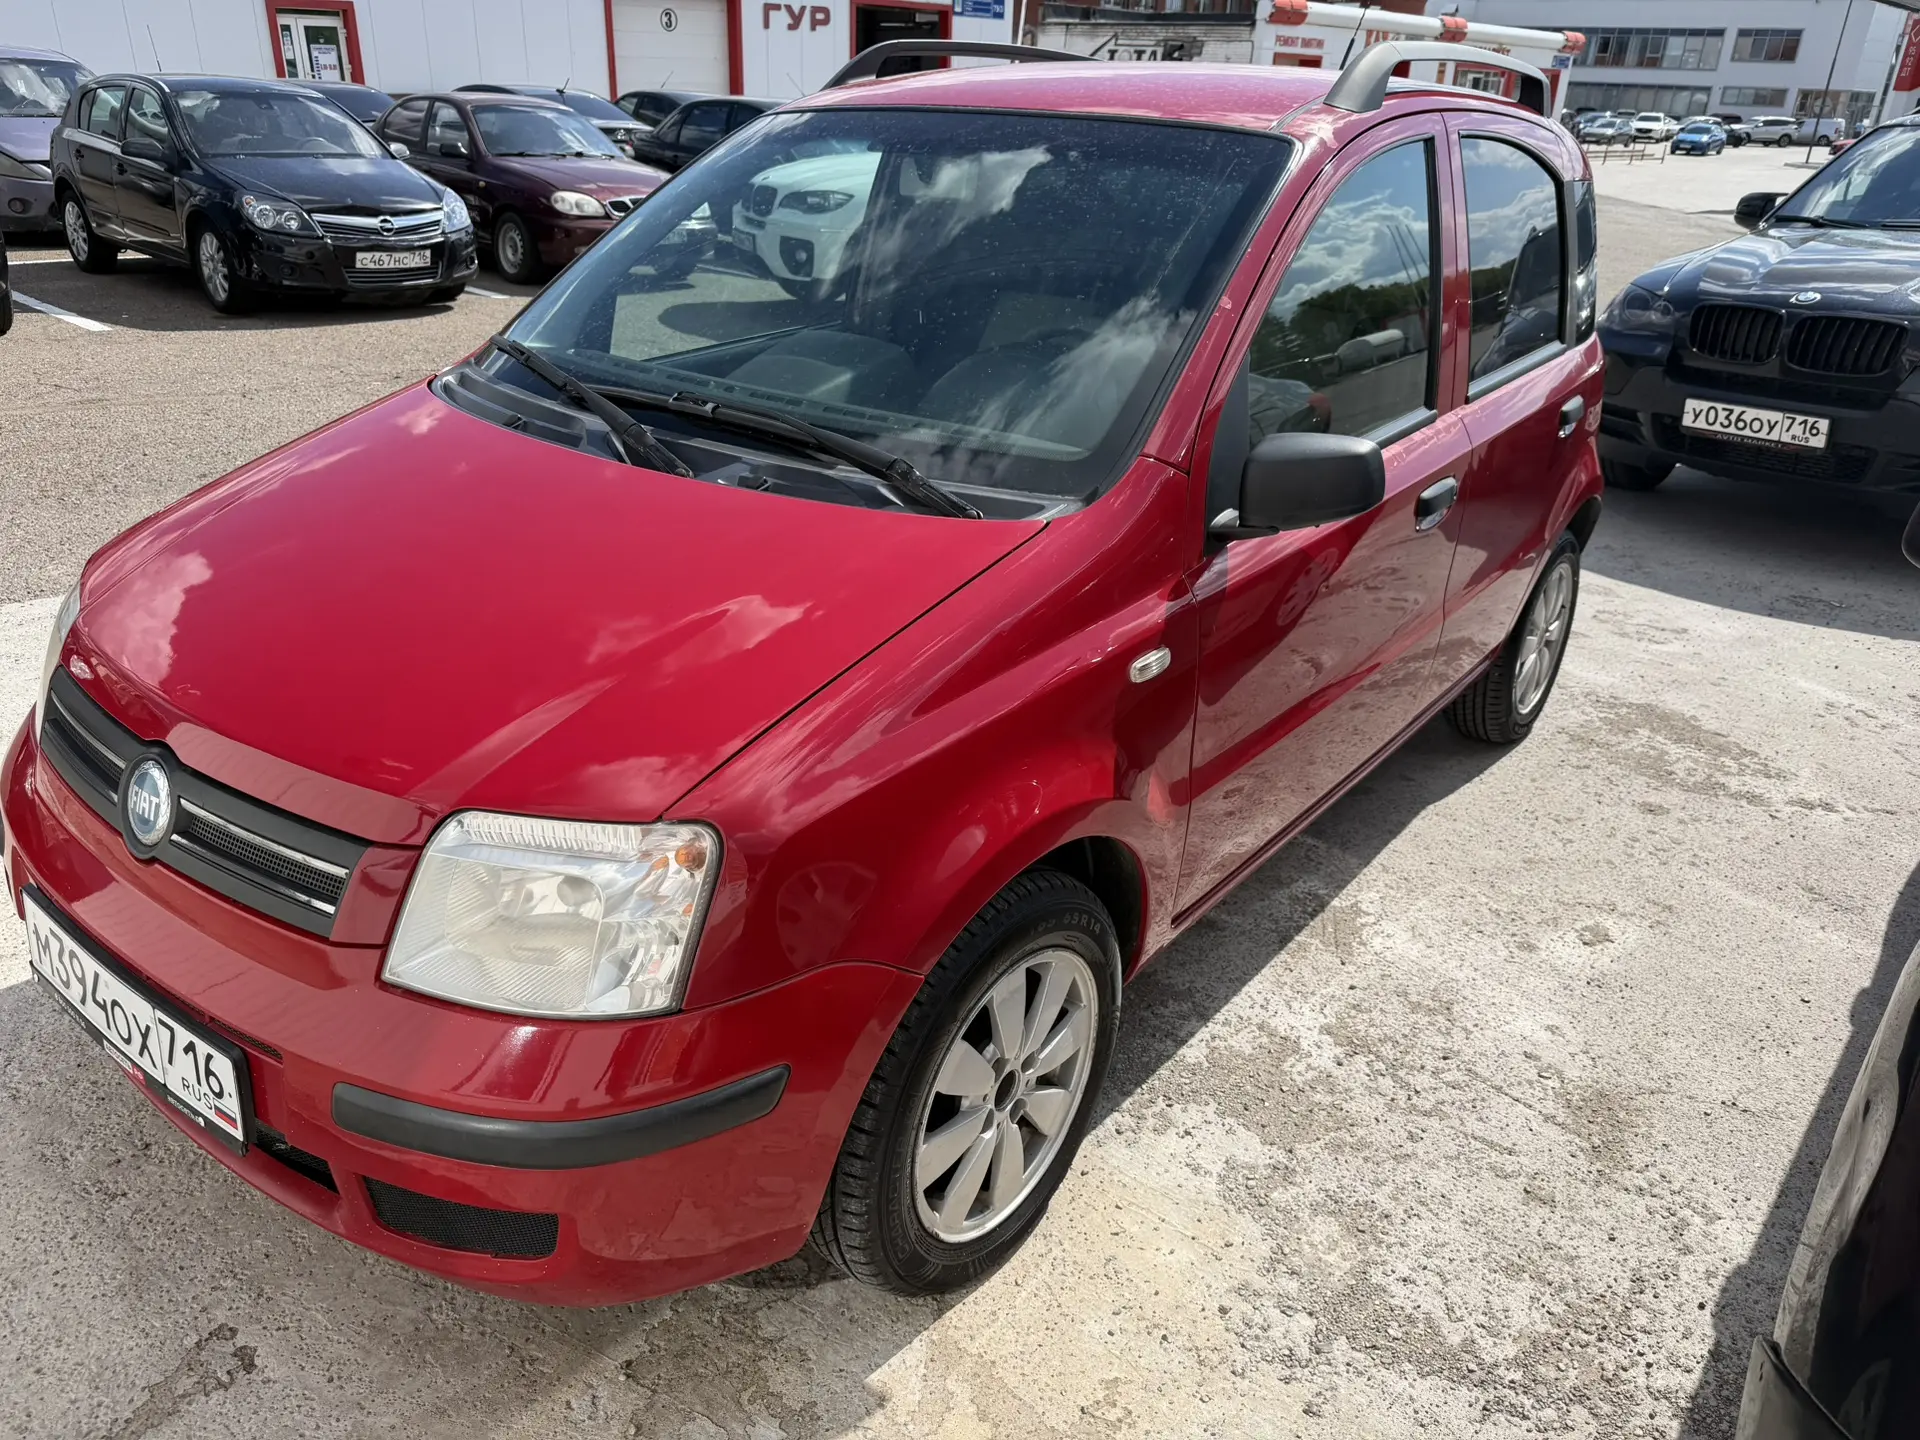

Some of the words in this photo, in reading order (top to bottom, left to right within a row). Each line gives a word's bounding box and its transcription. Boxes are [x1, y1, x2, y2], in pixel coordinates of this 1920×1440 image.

[664, 12, 673, 29] 3
[763, 3, 831, 32] ГУР
[1691, 405, 1779, 436] У036ОУ
[1785, 415, 1821, 437] 716
[1790, 433, 1811, 444] RUS
[131, 784, 160, 822] FIAT
[32, 922, 158, 1070] М394ОХ
[158, 1017, 225, 1100] 716
[181, 1076, 214, 1111] RUS
